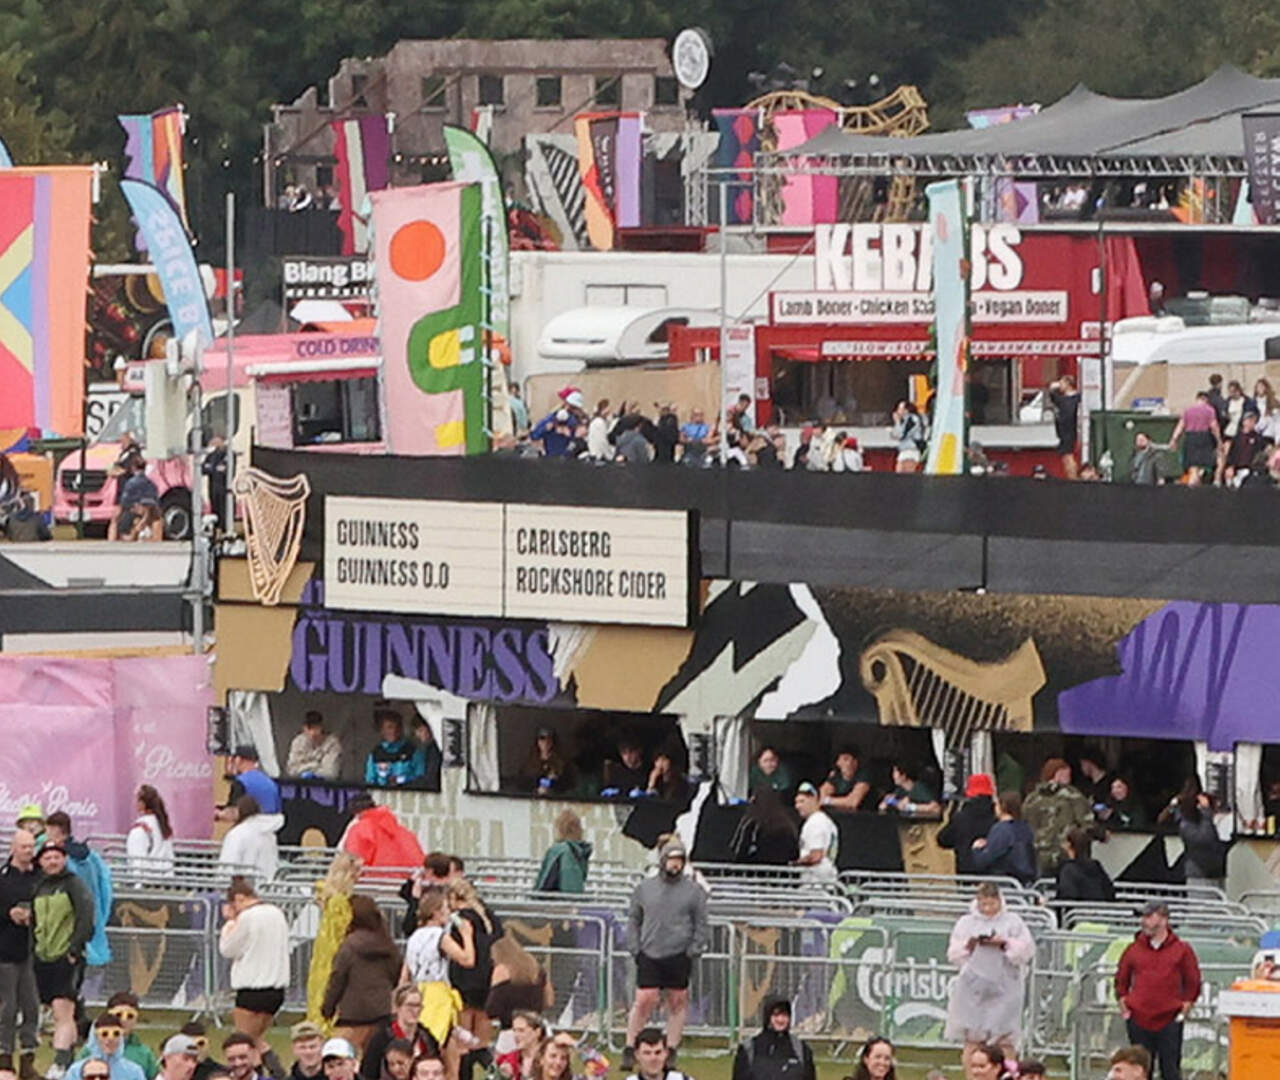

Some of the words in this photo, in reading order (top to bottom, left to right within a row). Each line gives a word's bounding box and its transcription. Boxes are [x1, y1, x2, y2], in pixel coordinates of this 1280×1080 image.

[284, 262, 348, 286] Blang
[779, 299, 813, 316] Lamb
[817, 299, 852, 316] Doner
[860, 299, 908, 317] Chicken
[986, 299, 1022, 318] Vegan
[1026, 300, 1061, 317] Doner
[296, 339, 337, 358] COLD
[339, 337, 380, 354] DRIN
[337, 519, 419, 550] GUINNESS
[516, 528, 611, 559] CARLSBERG
[337, 557, 419, 587] GUINNESS
[423, 563, 450, 591] 0.0
[516, 566, 614, 598] ROCKSHORE
[618, 571, 666, 601] CIDER
[291, 616, 562, 705] GUINNESS
[143, 744, 212, 779] Picnic
[856, 946, 958, 1012] Carlsb
